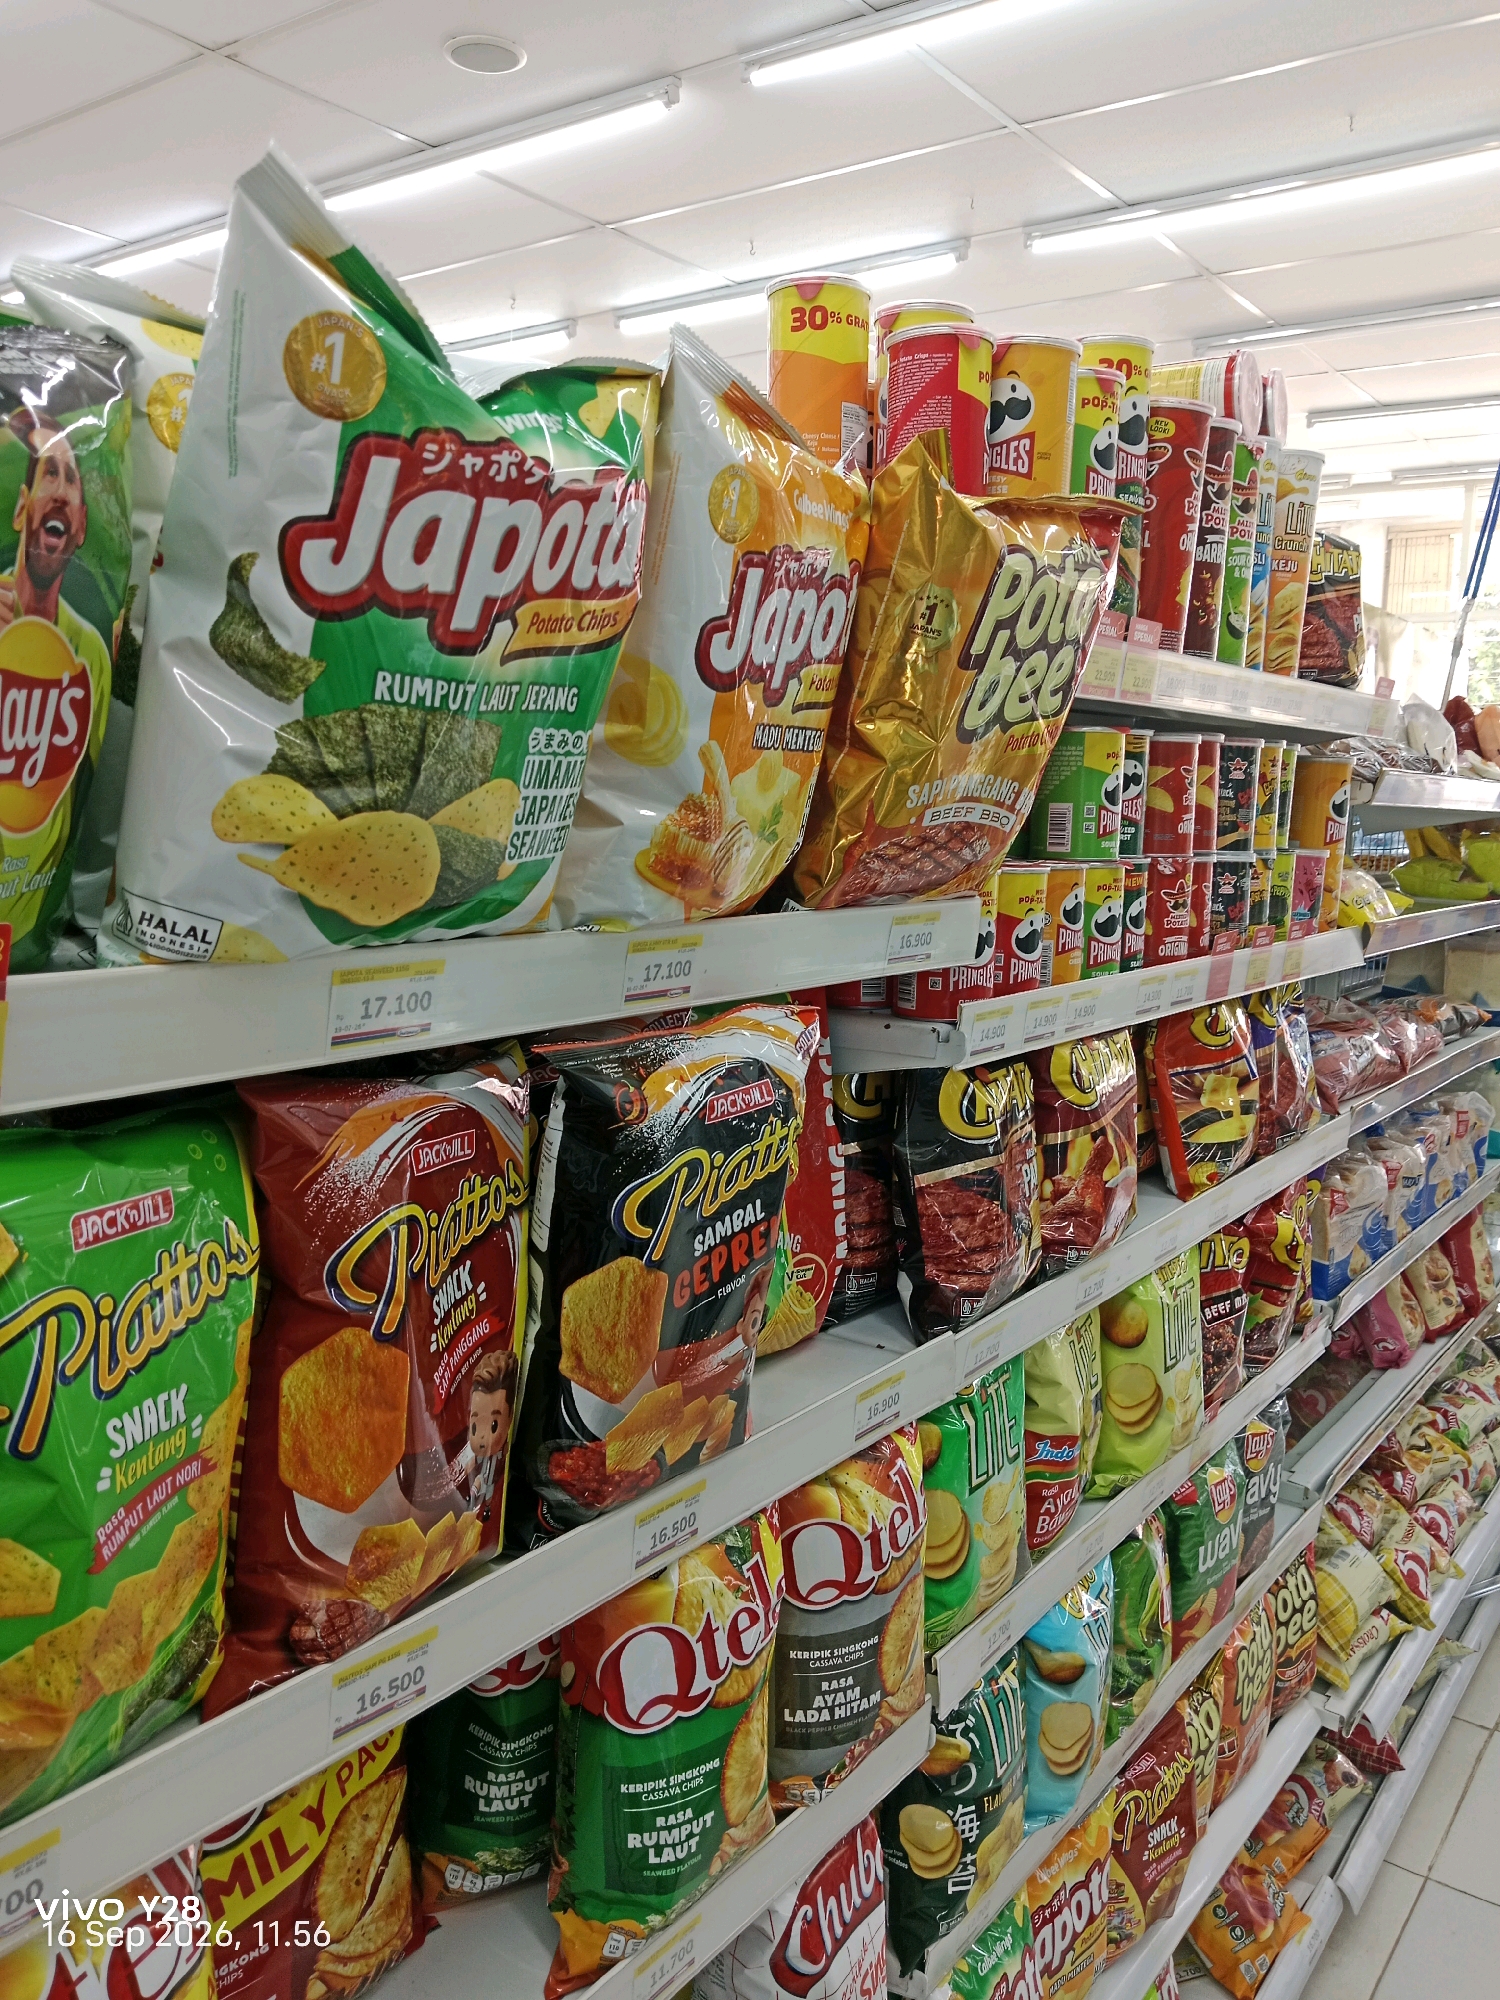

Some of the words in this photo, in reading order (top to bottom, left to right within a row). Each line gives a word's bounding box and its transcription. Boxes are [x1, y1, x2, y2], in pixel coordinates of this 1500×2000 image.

[791, 305, 842, 333] 30%
[309, 331, 348, 386] #1
[317, 383, 353, 399] SNACK
[820, 432, 837, 440] Cheese
[1149, 425, 1171, 435] LOOK!
[1154, 419, 1170, 427] NEW
[721, 478, 742, 518] #1
[299, 454, 647, 633] Japota
[1271, 558, 1298, 573] KEJU
[526, 611, 575, 635] Potato
[576, 607, 620, 633] Chips
[920, 600, 938, 622] #1
[909, 623, 943, 637] JAPAN'S
[375, 670, 477, 709] RUMPUT
[478, 680, 521, 712] LAUT
[521, 683, 579, 713] JEPANG
[963, 628, 1076, 730] bee
[0, 669, 86, 789] ay's
[753, 724, 782, 748] MADU
[1004, 727, 1037, 754] Potato
[906, 777, 947, 809] SAPI
[947, 772, 1017, 804] PANGGANG
[929, 802, 976, 824] BEEF
[978, 806, 1012, 828] BBQ
[22, 867, 57, 892] Laut
[1125, 876, 1143, 887] NEW
[135, 927, 209, 955] INDONESIA
[138, 910, 213, 946] HALAL
[899, 931, 933, 950] 16.900
[643, 959, 692, 983] 17.100
[360, 990, 432, 1020] 17.100
[1073, 1003, 1097, 1022] 14.900
[979, 1024, 1006, 1042] 14.900
[1033, 1012, 1058, 1029] 14.900
[693, 1198, 766, 1257] SAMBAL
[776, 1230, 802, 1253] ANG
[324, 1157, 529, 1343] Piattos
[795, 1272, 807, 1280] Cut
[432, 1259, 474, 1326] SNACK
[436, 1293, 477, 1352] Kentang
[1204, 1300, 1231, 1320] BEEF
[433, 1352, 449, 1386] Rasa
[439, 1371, 451, 1399] SAPI
[449, 1318, 491, 1370] PANGGANG
[106, 1383, 188, 1459] SNACK
[867, 1392, 900, 1422] 16.900
[115, 1425, 188, 1493] Kentang
[1245, 1462, 1282, 1505] avy
[102, 1503, 144, 1561] RUMPUT
[146, 1477, 173, 1512] LAUT
[176, 1458, 202, 1487] NORI
[141, 1512, 163, 1536] SEAWEED
[162, 1496, 179, 1514] FLAVOR
[97, 1506, 126, 1543] Rasa
[649, 1511, 697, 1550] 16.500
[781, 1458, 925, 1607] Qtel
[600, 1554, 784, 1729] Qtel
[789, 1648, 831, 1660] KERIPIK
[832, 1635, 879, 1658] SINGKONG
[808, 1655, 843, 1668] CASSAVA
[843, 1650, 865, 1663] CHIPS
[356, 1665, 425, 1714] 16.500
[812, 1687, 861, 1709] AYAM
[820, 1676, 854, 1692] RASA
[783, 1704, 831, 1723] LADA
[834, 1691, 881, 1719] HITAM
[468, 1722, 501, 1749] KERIPIK
[501, 1723, 554, 1751] SINGKONG
[785, 1724, 806, 1734] BLACK
[806, 1722, 830, 1733] PEPPER
[830, 1718, 857, 1731] CHICKEN
[479, 1742, 513, 1759] CASSAVA
[514, 1741, 538, 1757] CHIPS
[464, 1770, 550, 1799] RUMPUT
[487, 1770, 526, 1782] RASA
[620, 1778, 668, 1793] KERIPIK
[668, 1757, 720, 1786] SINGKONG
[641, 1787, 682, 1802] CASSAVA
[682, 1776, 704, 1792] CHIPS
[473, 1814, 506, 1823] SEAWEED
[506, 1808, 537, 1822] FLAVOUR
[478, 1793, 533, 1813] LAUT
[1112, 1751, 1195, 1853] Piattos
[627, 1810, 715, 1849] RUMPUT
[656, 1807, 693, 1828] RASA
[1147, 1816, 1178, 1848] SNACK
[201, 1780, 328, 1923] MILY
[648, 1835, 700, 1865] LAUT
[1149, 1830, 1180, 1862] Kentang
[642, 1867, 676, 1878] SEAWEED
[650, 1938, 694, 1984] 11.700
[977, 1953, 996, 1976] Calbee
[994, 1931, 1013, 1959] Wings
[1049, 1976, 1066, 1998] MADU
[1066, 1953, 1095, 1982] MENTEGA
